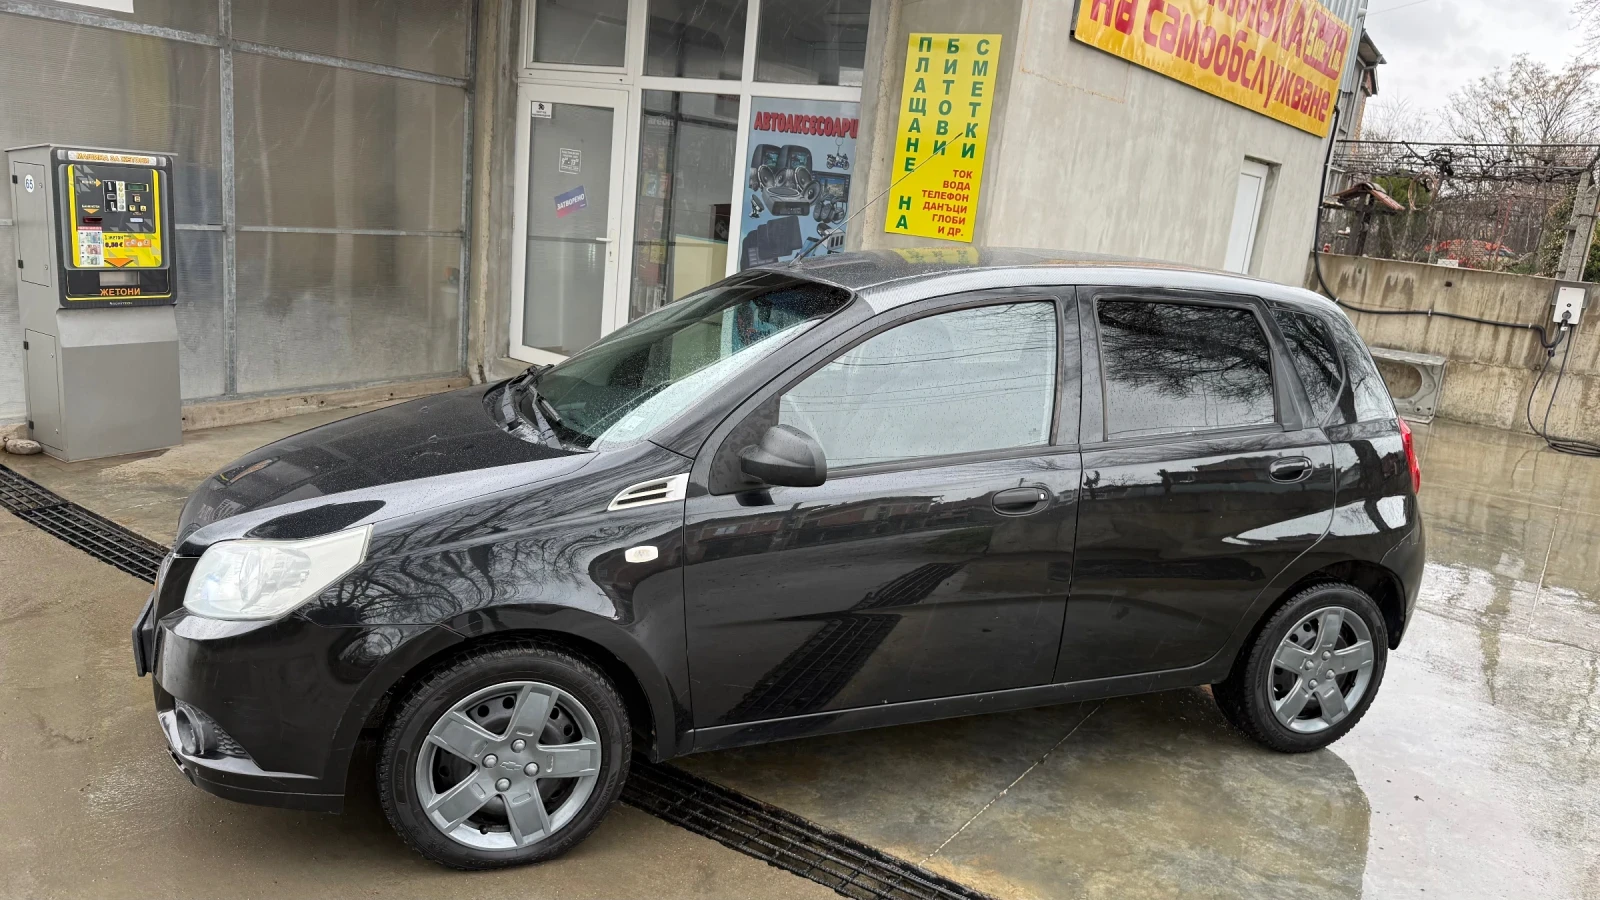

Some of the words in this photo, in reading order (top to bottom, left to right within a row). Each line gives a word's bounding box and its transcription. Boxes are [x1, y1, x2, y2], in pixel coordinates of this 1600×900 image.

[1143, 0, 1331, 122] самообслужване
[933, 38, 960, 155] БИТОВИ
[961, 39, 990, 159] СМЕТКИ
[904, 37, 932, 172] ПЛАЩАНЕ
[953, 170, 973, 179] ТОК
[26, 178, 33, 189] 65
[943, 181, 970, 191] ВОДА
[557, 193, 585, 211] ЗАТВОРЕНО
[922, 190, 969, 202] ТЕЛЕФОН
[896, 196, 911, 229] НА
[923, 202, 967, 214] ДАНЪЦИ
[932, 214, 965, 225] ГЛОБИ
[938, 226, 945, 234] И
[947, 227, 964, 237] ДР.
[100, 288, 141, 296] ЖЕТОНИ
